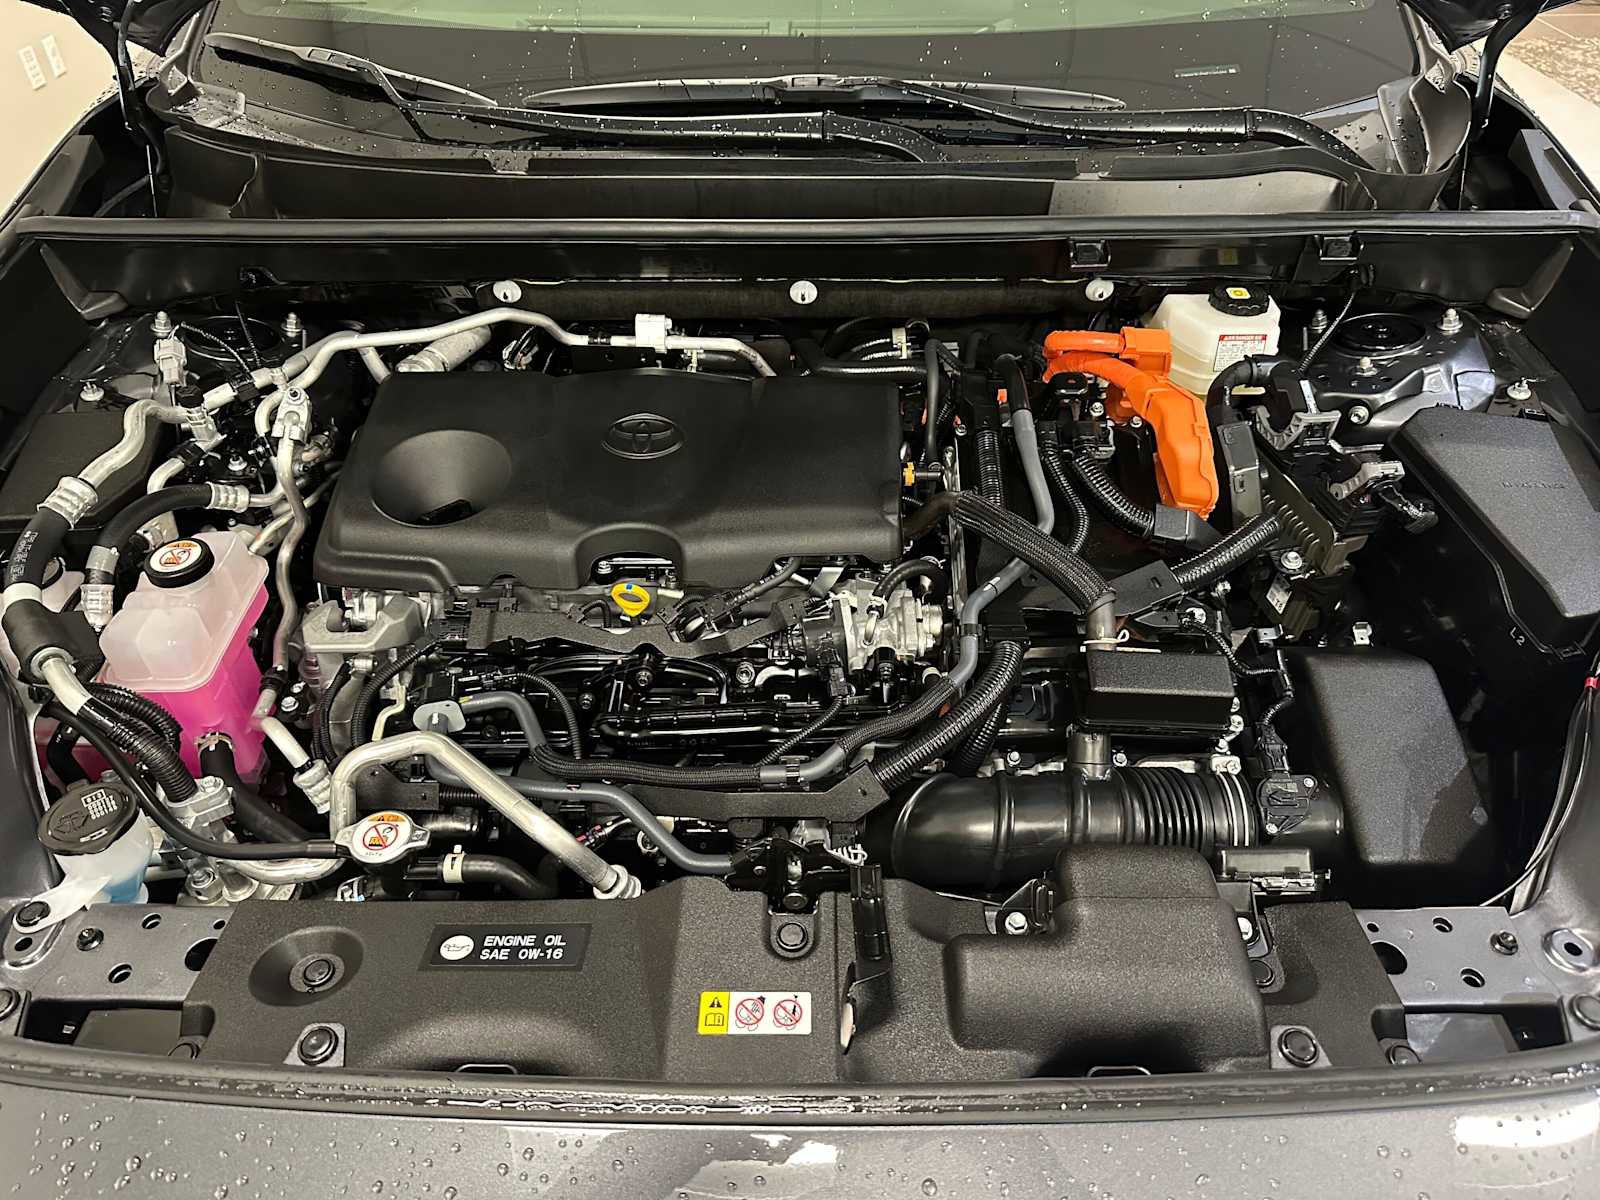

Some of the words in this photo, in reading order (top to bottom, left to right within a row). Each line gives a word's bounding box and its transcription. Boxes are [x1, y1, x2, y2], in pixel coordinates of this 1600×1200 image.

[484, 935, 536, 946] ENGINE
[544, 935, 566, 946] OIL
[480, 949, 510, 960] SAE
[518, 947, 564, 960] 0W-16
